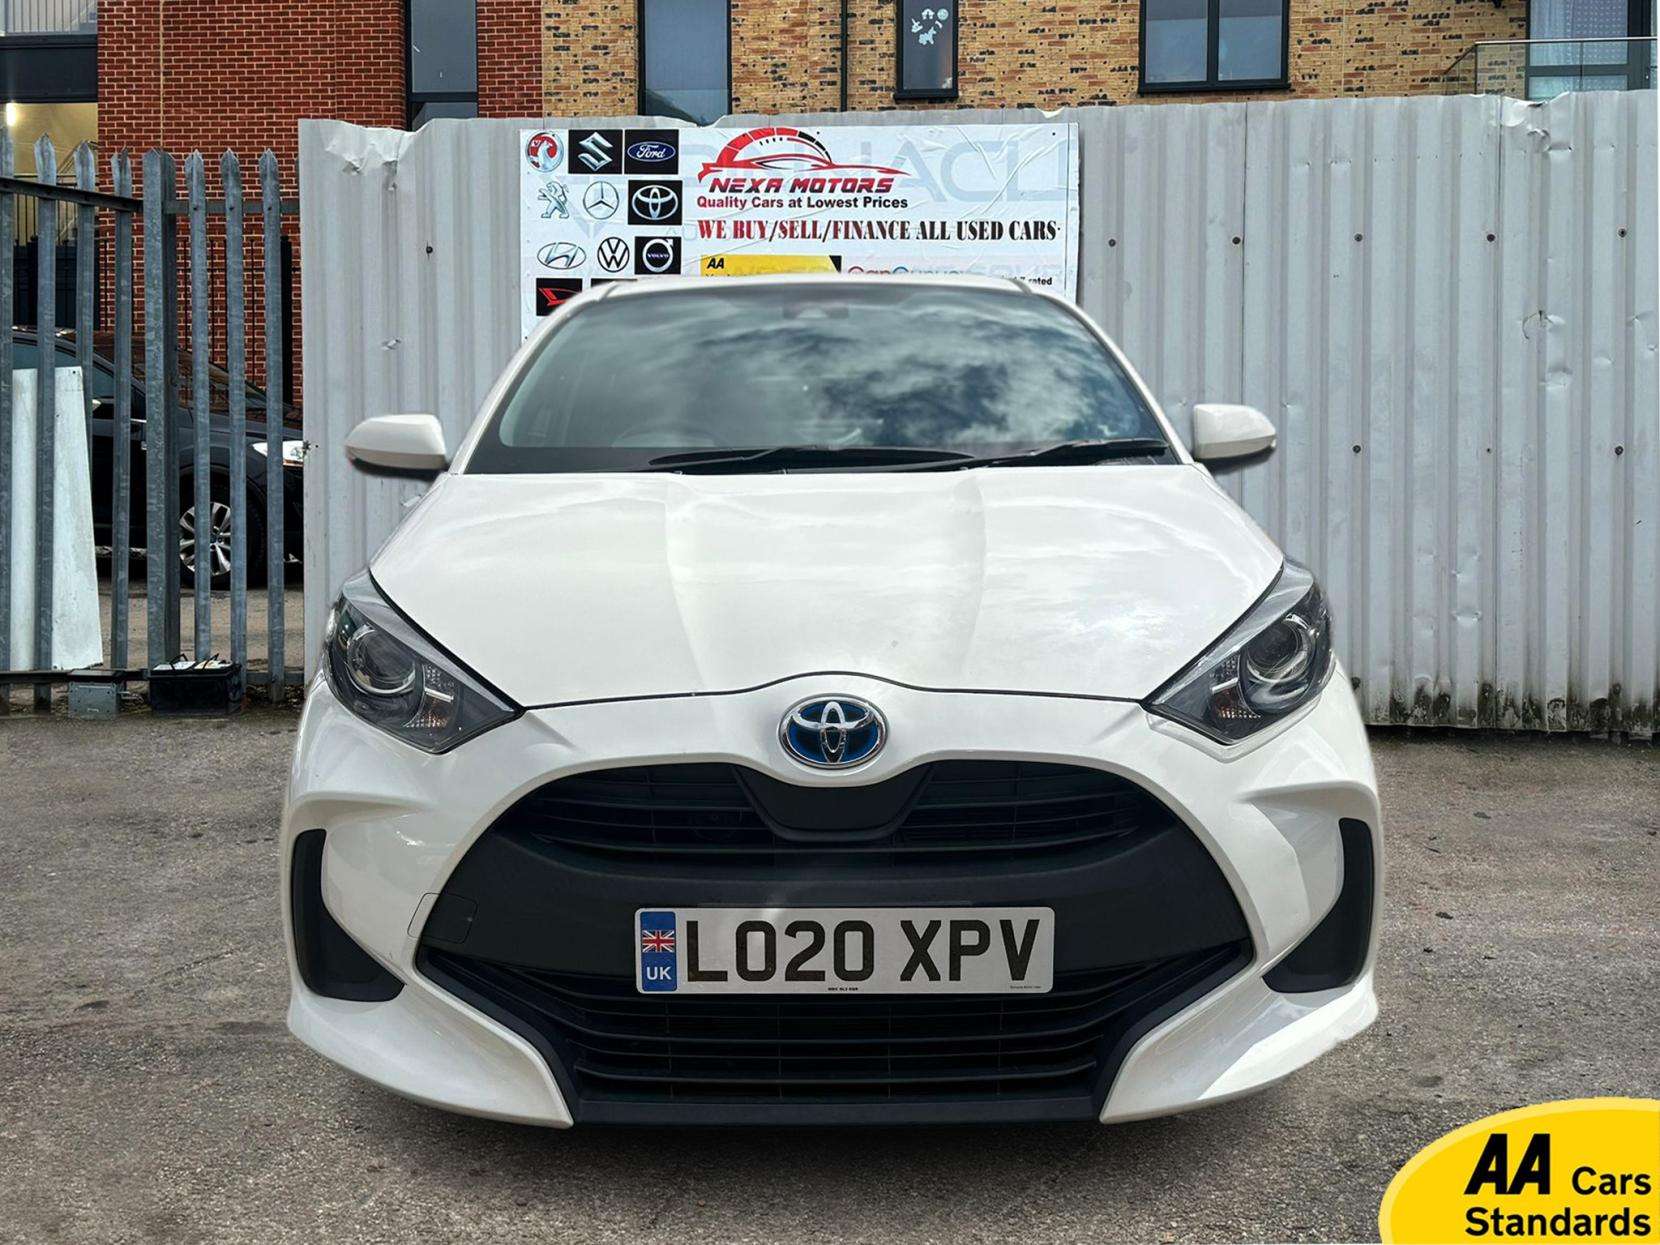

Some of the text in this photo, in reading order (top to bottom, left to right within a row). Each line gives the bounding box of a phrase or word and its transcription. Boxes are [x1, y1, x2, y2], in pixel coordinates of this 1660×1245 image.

[636, 144, 666, 159] Ford
[708, 177, 894, 194] NEXA MOTORS
[697, 195, 908, 210] Quality Cars at Lowest Prices
[697, 219, 727, 240] WE
[733, 219, 910, 243] BUY/SELL/FINANCE
[916, 220, 951, 240] ALL
[957, 220, 1004, 240] USED
[1009, 220, 1057, 241] CARS
[706, 257, 725, 269] AA
[686, 918, 1041, 982] LO20 XPV
[646, 966, 672, 981] UK
